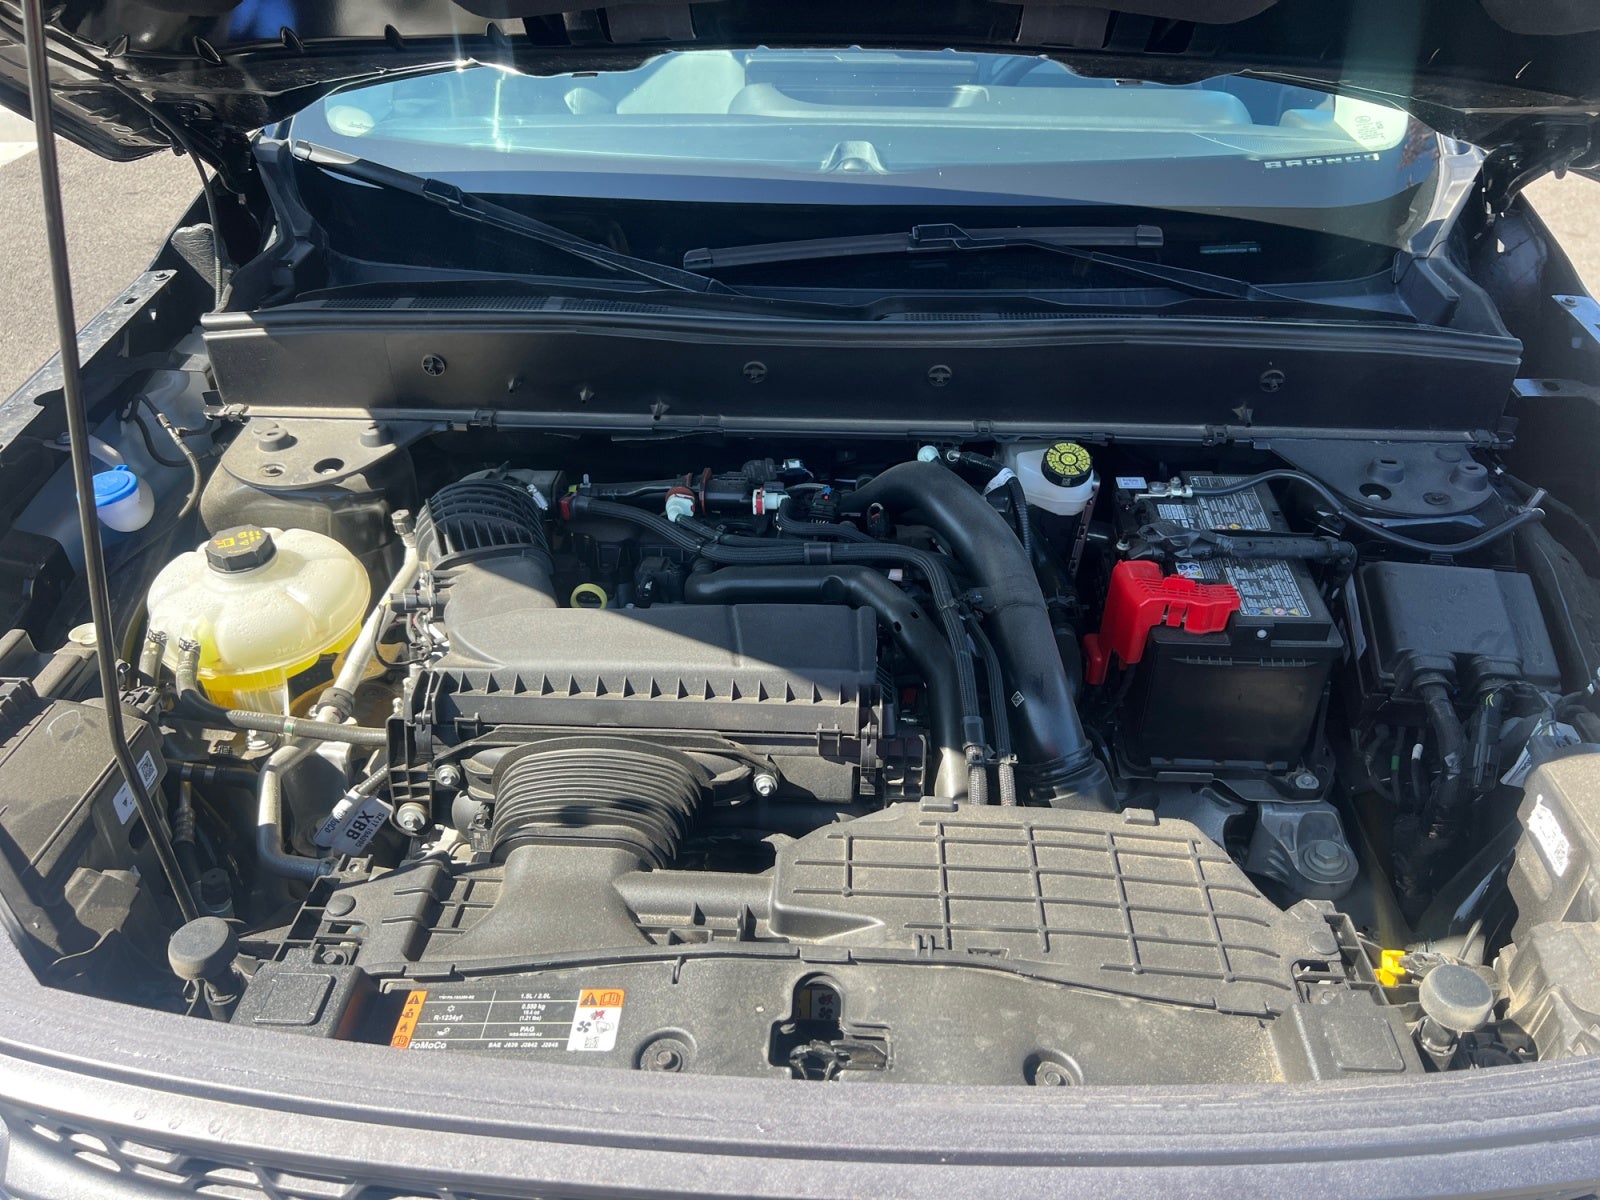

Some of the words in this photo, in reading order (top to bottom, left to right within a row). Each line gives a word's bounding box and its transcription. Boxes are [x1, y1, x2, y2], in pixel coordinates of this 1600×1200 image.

[1264, 153, 1379, 169] BRONCO
[346, 810, 374, 840] XBB
[408, 1041, 447, 1049] FoMoCo
